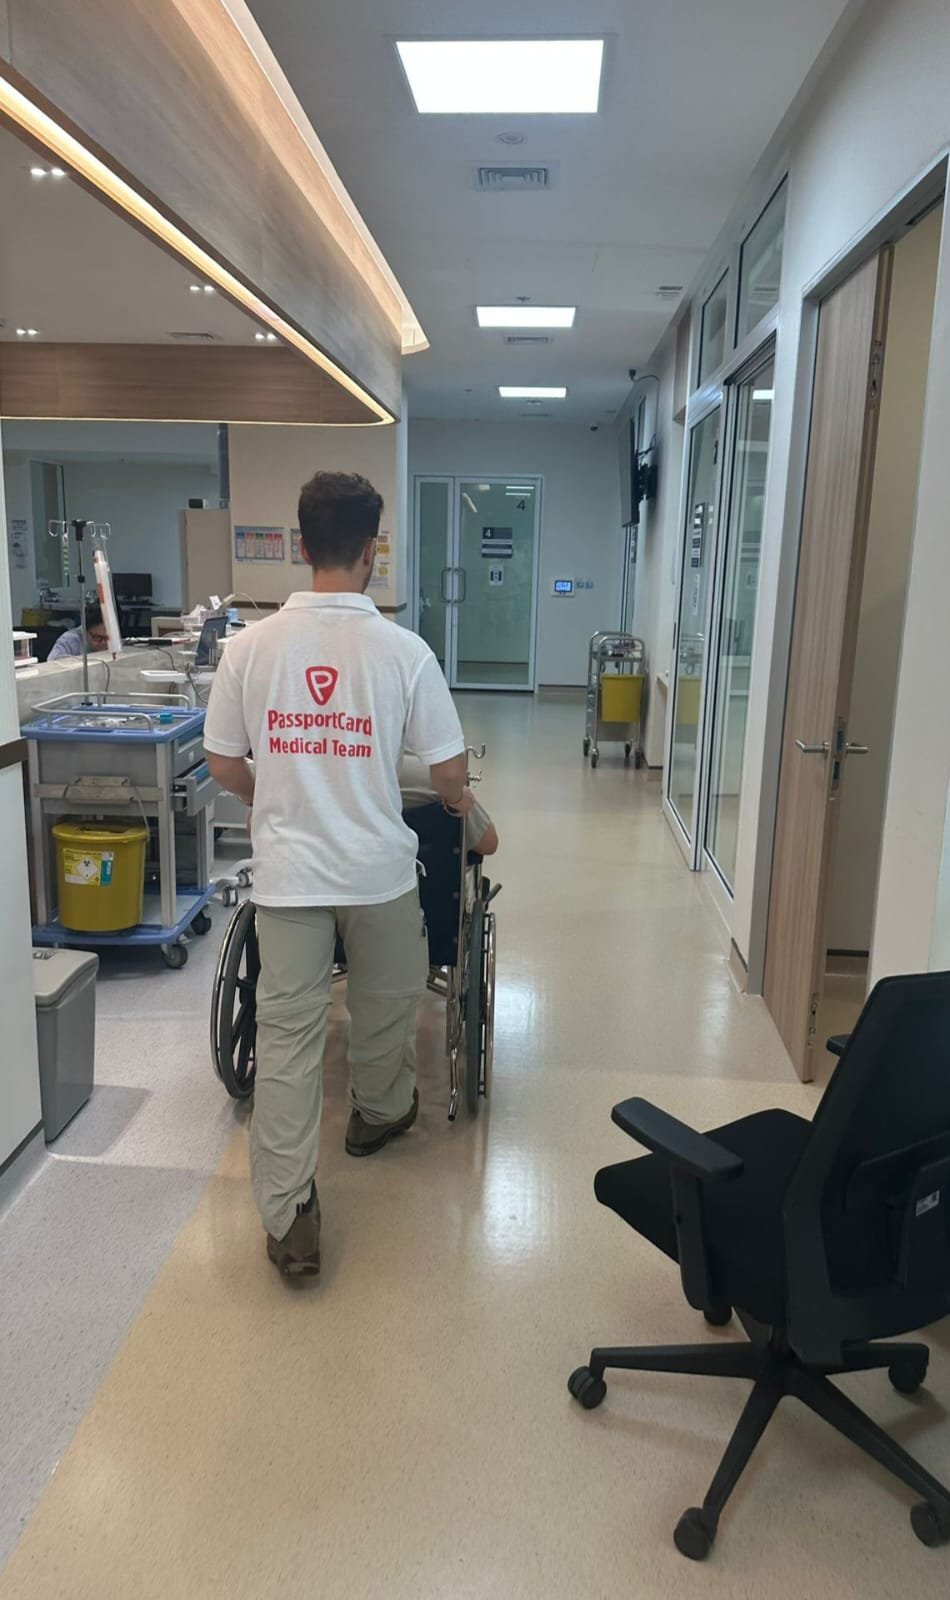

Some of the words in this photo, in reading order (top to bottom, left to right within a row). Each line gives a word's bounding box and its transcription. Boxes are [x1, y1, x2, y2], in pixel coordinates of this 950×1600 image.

[516, 499, 525, 511] 4
[308, 669, 334, 702] P
[267, 709, 372, 736] PassportCard
[269, 737, 327, 754] Medical
[332, 738, 371, 757] Team
